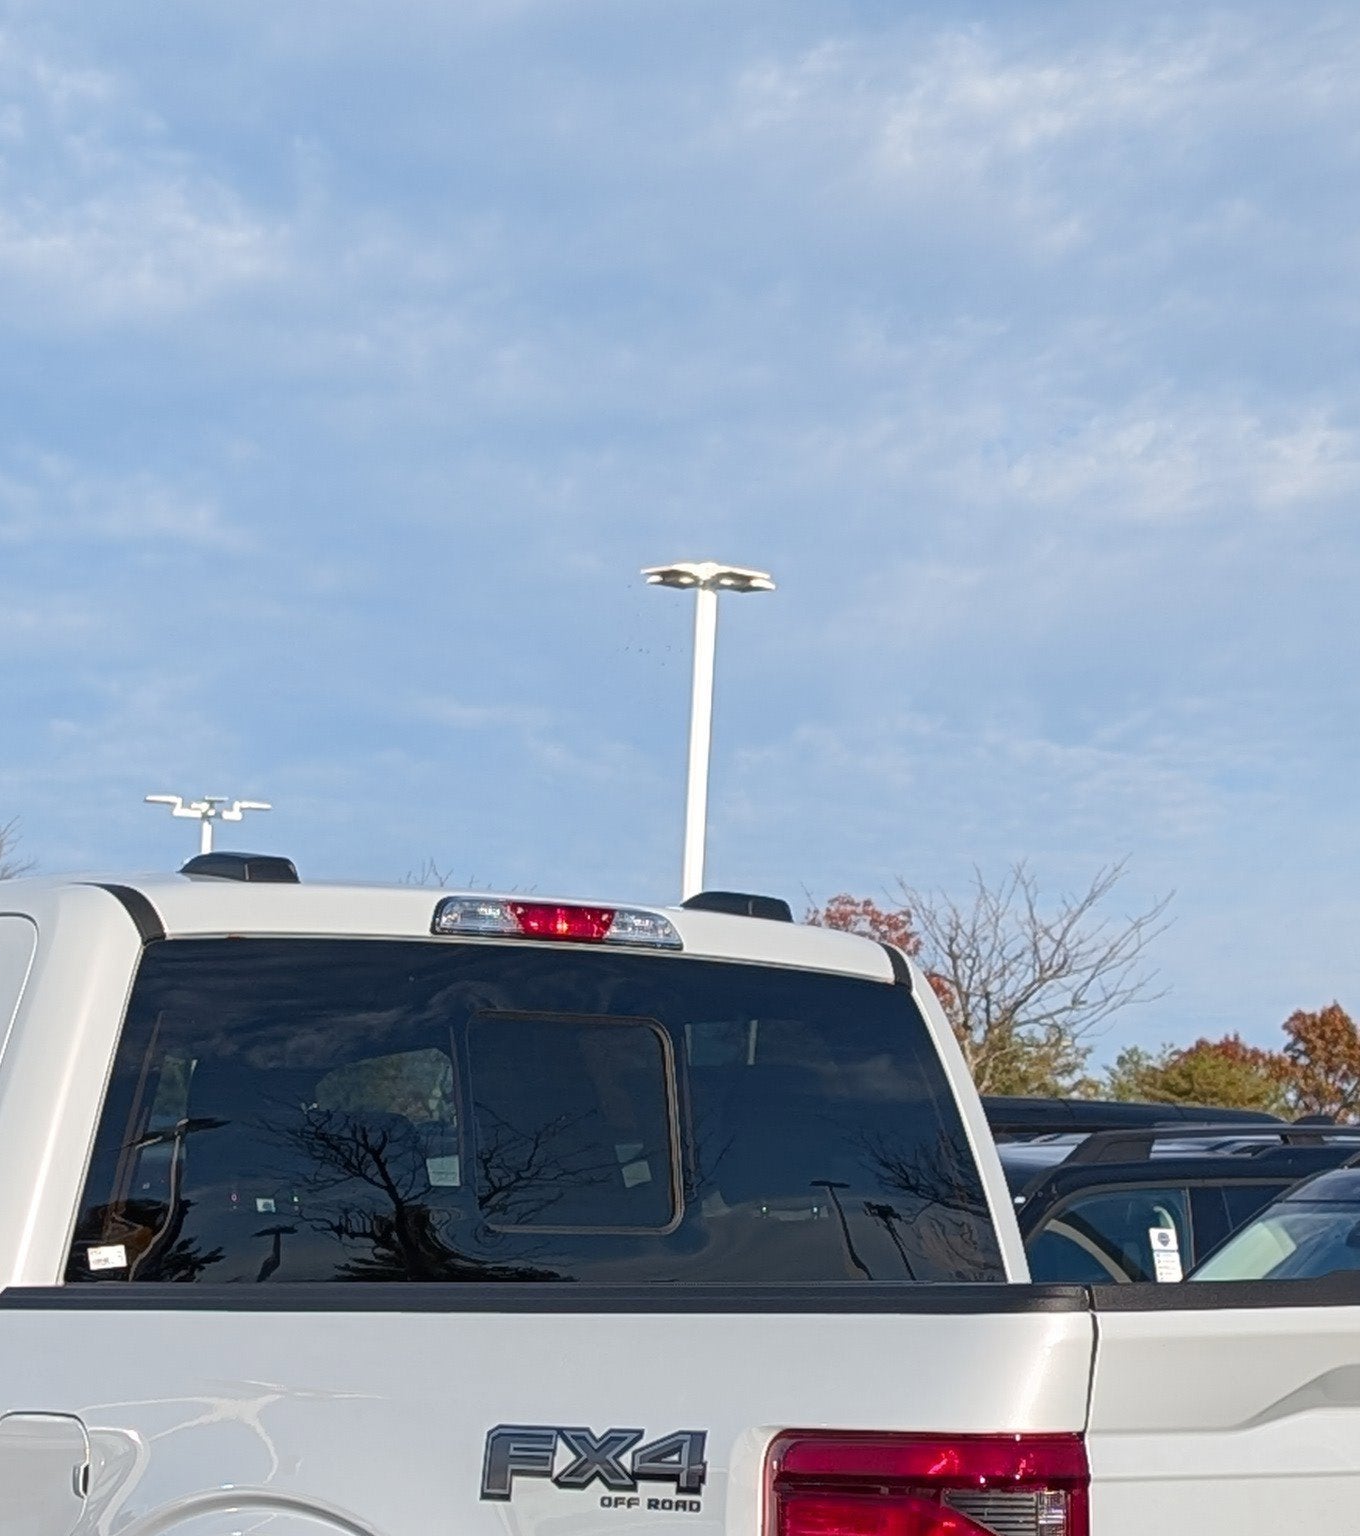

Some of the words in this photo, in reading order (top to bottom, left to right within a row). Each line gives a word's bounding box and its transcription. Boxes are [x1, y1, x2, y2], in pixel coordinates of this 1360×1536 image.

[479, 1424, 708, 1501] FX4
[599, 1496, 640, 1509] OFF
[647, 1498, 701, 1513] ROAD
